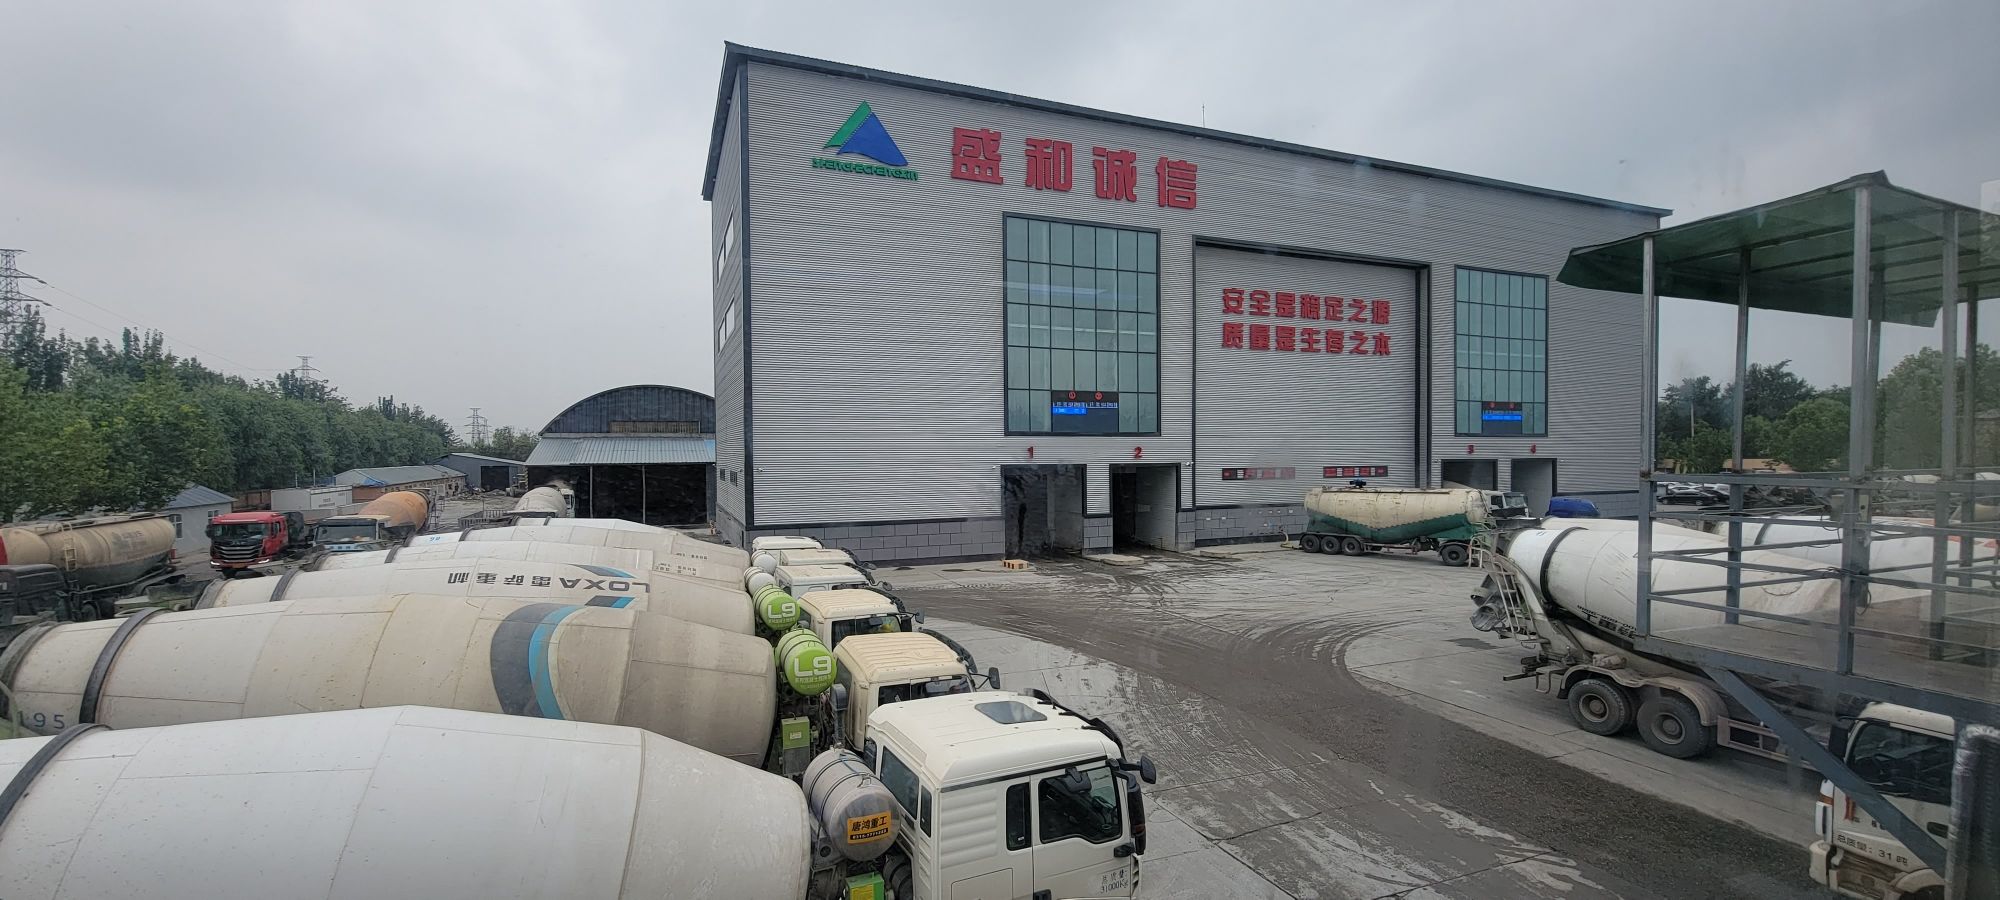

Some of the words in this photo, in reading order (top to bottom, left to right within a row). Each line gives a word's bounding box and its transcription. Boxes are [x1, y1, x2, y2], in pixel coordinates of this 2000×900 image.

[951, 126, 1198, 210] 盛和诚信
[1222, 288, 1391, 324] 安全是稳定之源
[1027, 447, 1034, 459] 1
[1134, 446, 1142, 459] 2
[1467, 444, 1475, 454] 3
[559, 577, 650, 593] LOXA
[767, 602, 796, 619] L9
[794, 655, 833, 678] L9
